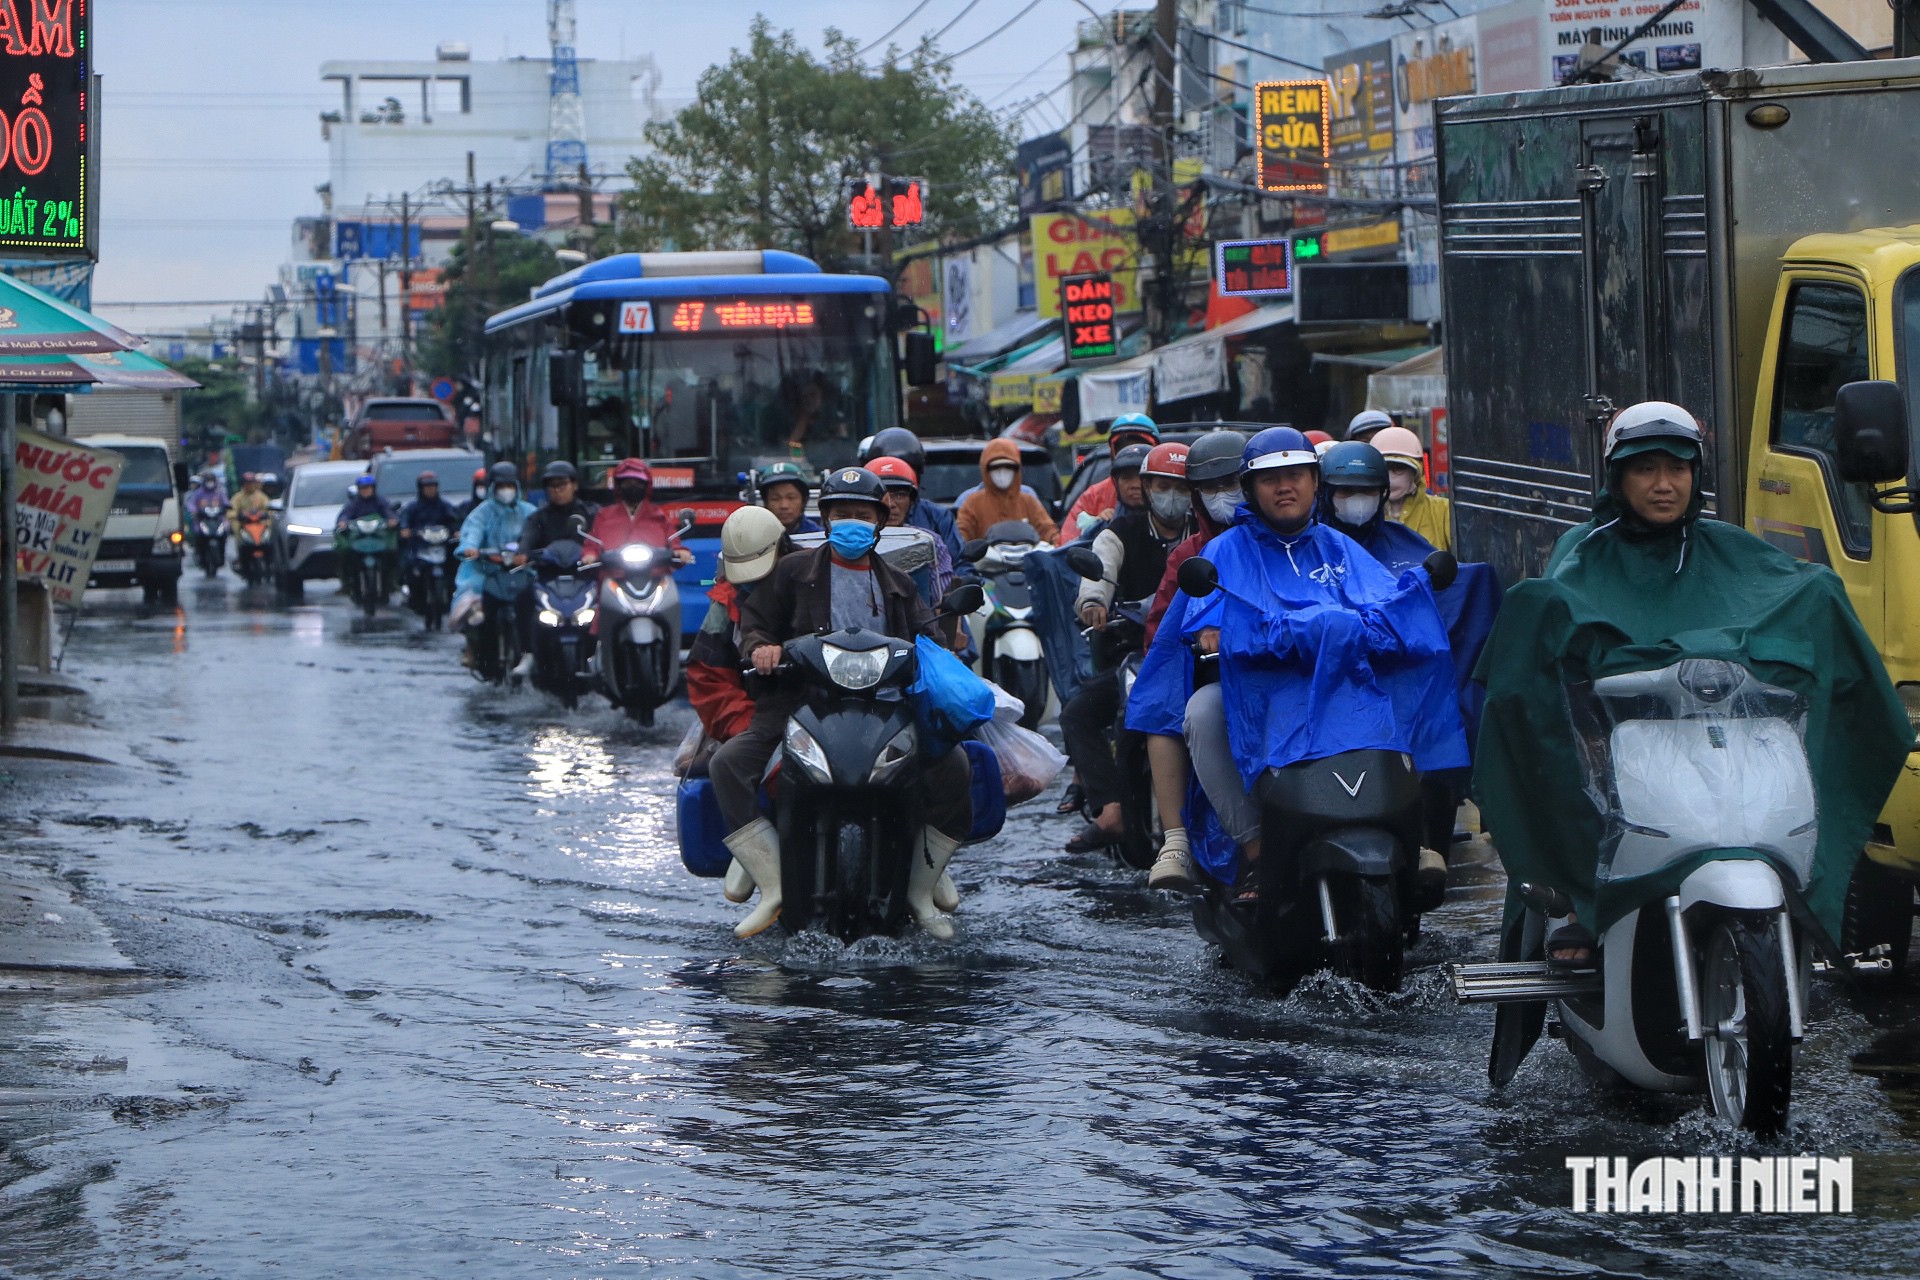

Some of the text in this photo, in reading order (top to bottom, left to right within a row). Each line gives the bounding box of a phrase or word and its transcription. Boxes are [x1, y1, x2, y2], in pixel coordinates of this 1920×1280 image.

[1600, 25, 1629, 42] ÍNH
[1635, 20, 1694, 38] AMING
[1264, 116, 1320, 149] CỬA
[43, 200, 78, 238] 2%
[1065, 279, 1112, 301] DÁN
[624, 307, 649, 329] 47
[672, 302, 704, 331] 47
[1067, 303, 1113, 323] KEO
[69, 340, 98, 348] Long
[1075, 324, 1112, 345] XE
[41, 369, 74, 377] Long
[16, 441, 114, 490] NƯỚC
[18, 482, 83, 521] MÍA
[72, 528, 92, 545] LY
